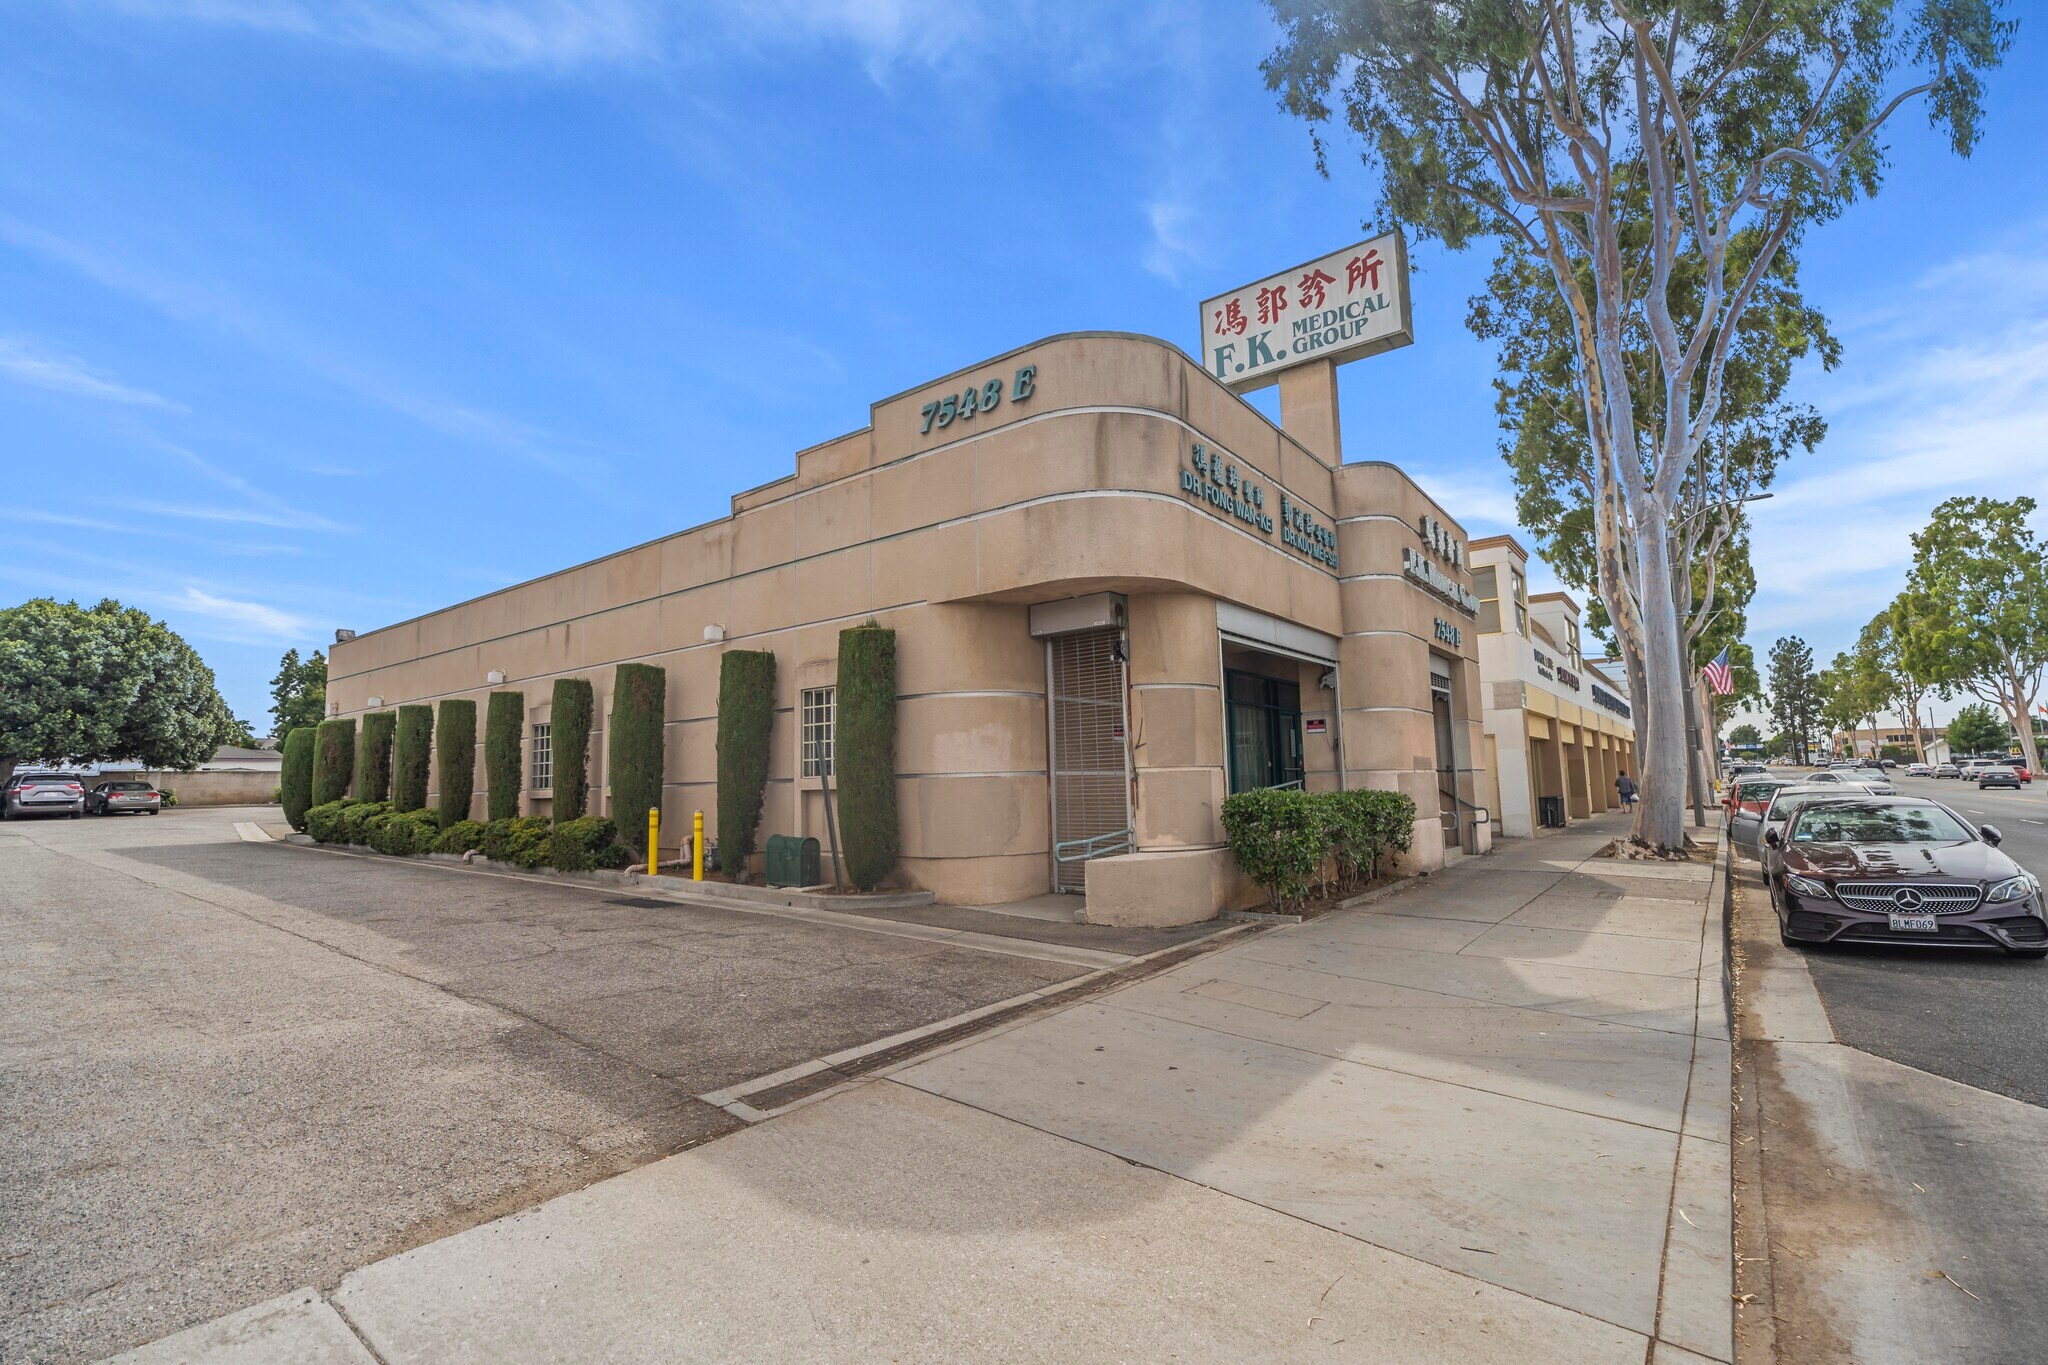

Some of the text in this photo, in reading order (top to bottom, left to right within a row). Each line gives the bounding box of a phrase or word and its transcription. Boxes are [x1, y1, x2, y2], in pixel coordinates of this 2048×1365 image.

[1214, 248, 1385, 337] 馮郭診所
[1292, 292, 1391, 338] MEDICAL
[1214, 330, 1287, 379] F.K.
[1292, 317, 1369, 355] GROUP
[920, 363, 1037, 434] 7548 E
[1181, 469, 1274, 535] DR. FONG WAN-KEI
[1434, 617, 1455, 644] 7548
[1892, 919, 1934, 929] 8LMF069
